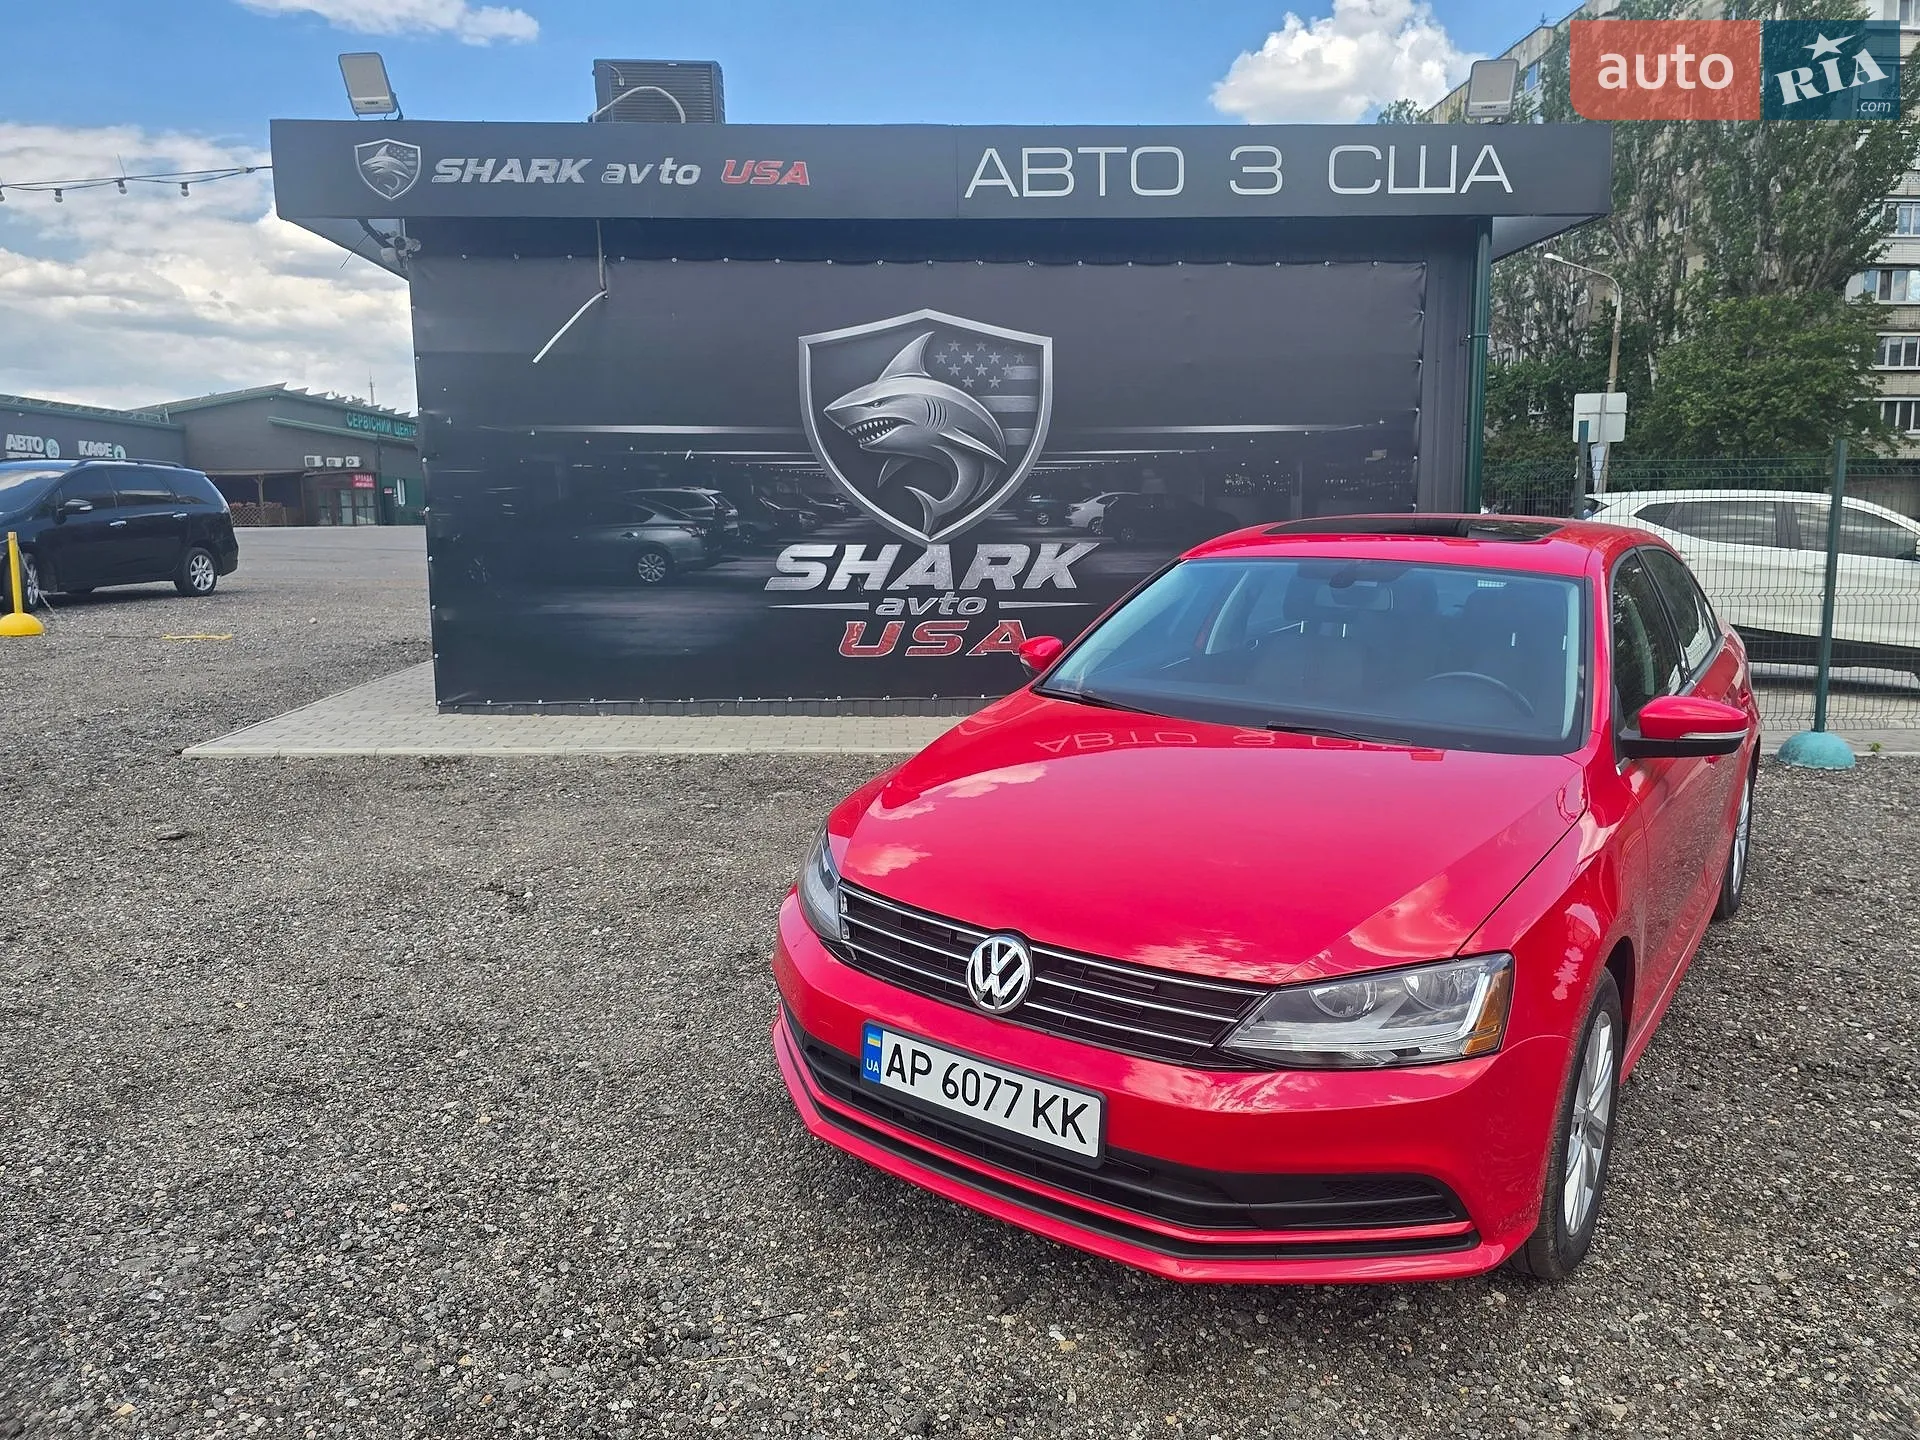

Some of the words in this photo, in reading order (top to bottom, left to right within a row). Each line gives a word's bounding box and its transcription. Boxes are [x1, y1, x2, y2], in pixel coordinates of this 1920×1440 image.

[432, 158, 592, 184] SHARK
[721, 159, 810, 186] USA
[964, 146, 1185, 198] АВТО
[1328, 144, 1513, 195] США
[5, 433, 45, 453] АВТО
[78, 440, 113, 457] КАФЕ
[764, 543, 1100, 591] SHARK
[875, 591, 988, 616] avto
[838, 619, 1028, 658] USA
[866, 1058, 880, 1075] UA
[885, 1043, 933, 1087] AP
[941, 1062, 1024, 1119] 6077
[1032, 1088, 1089, 1145] KK
